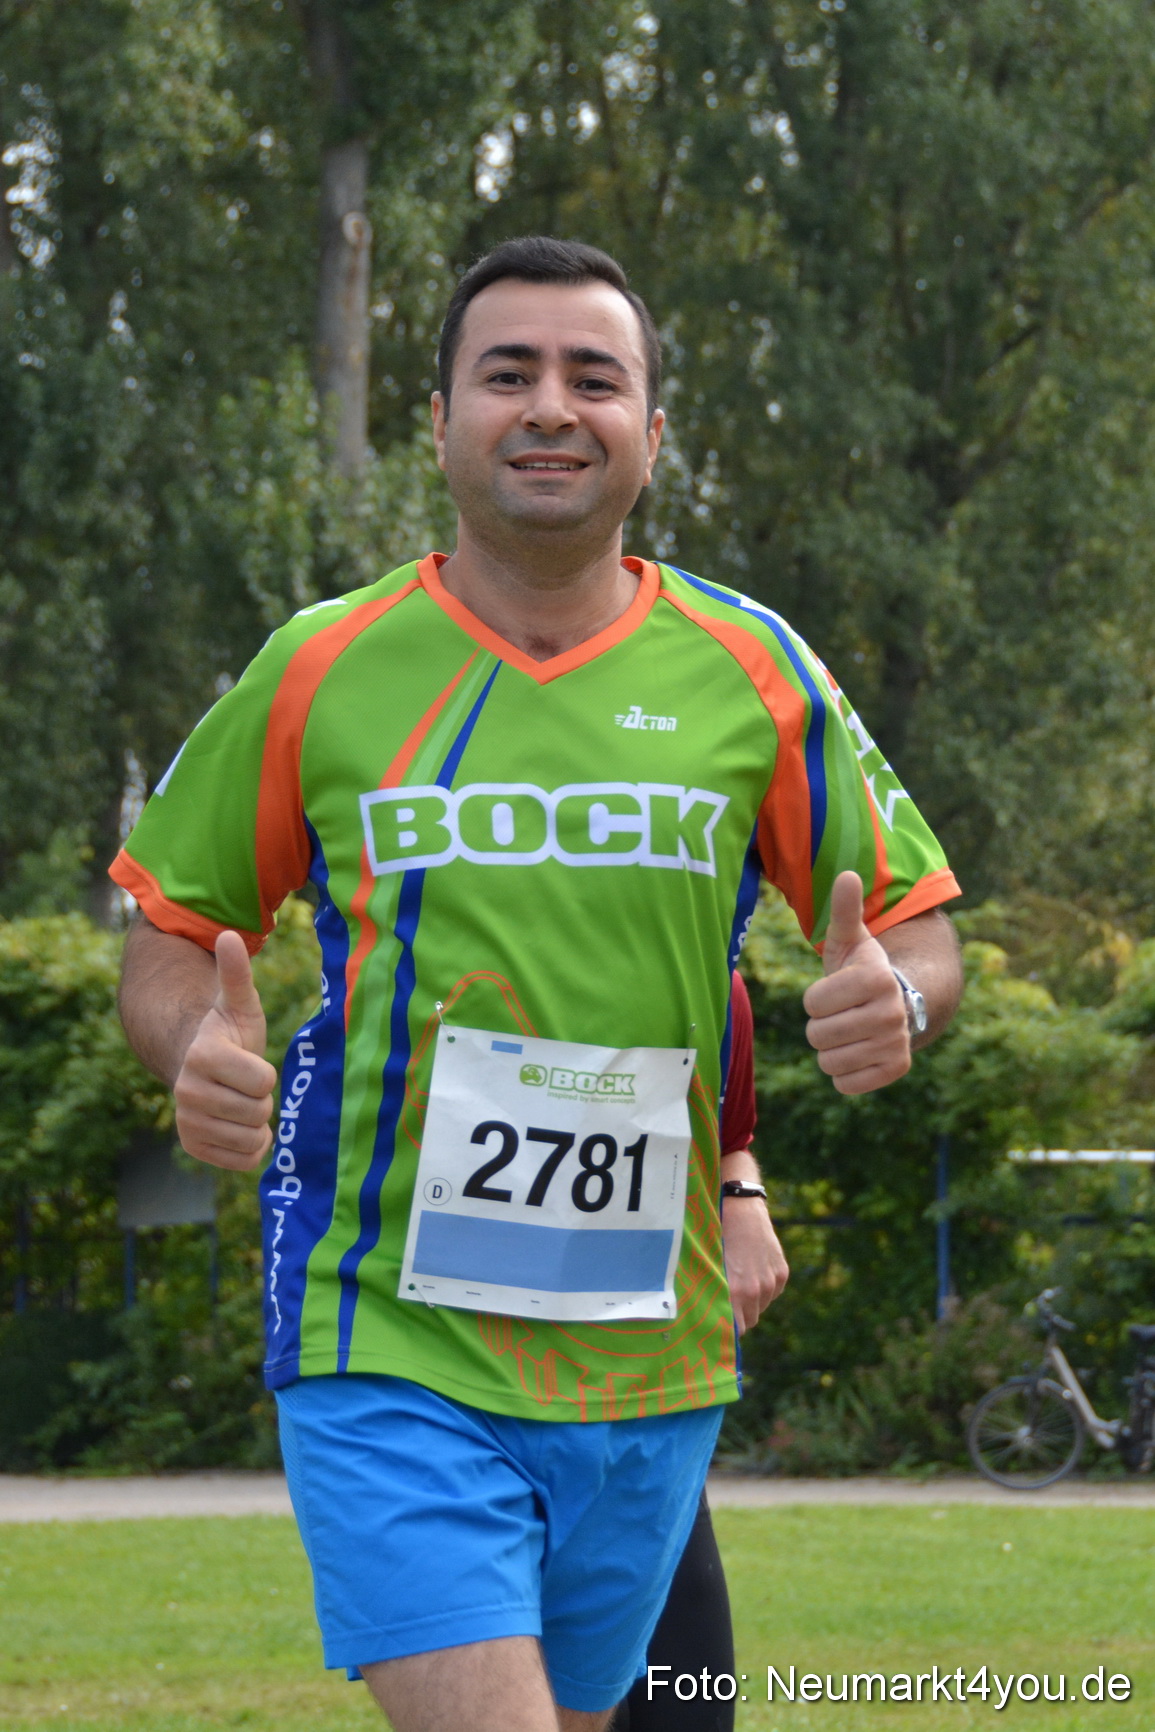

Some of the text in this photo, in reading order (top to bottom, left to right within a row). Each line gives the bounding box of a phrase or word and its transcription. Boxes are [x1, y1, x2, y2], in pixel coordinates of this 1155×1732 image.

[359, 782, 730, 878] BOCK
[549, 1067, 636, 1095] BOCK
[432, 1185, 443, 1199] D
[462, 1120, 649, 1213] 2781
